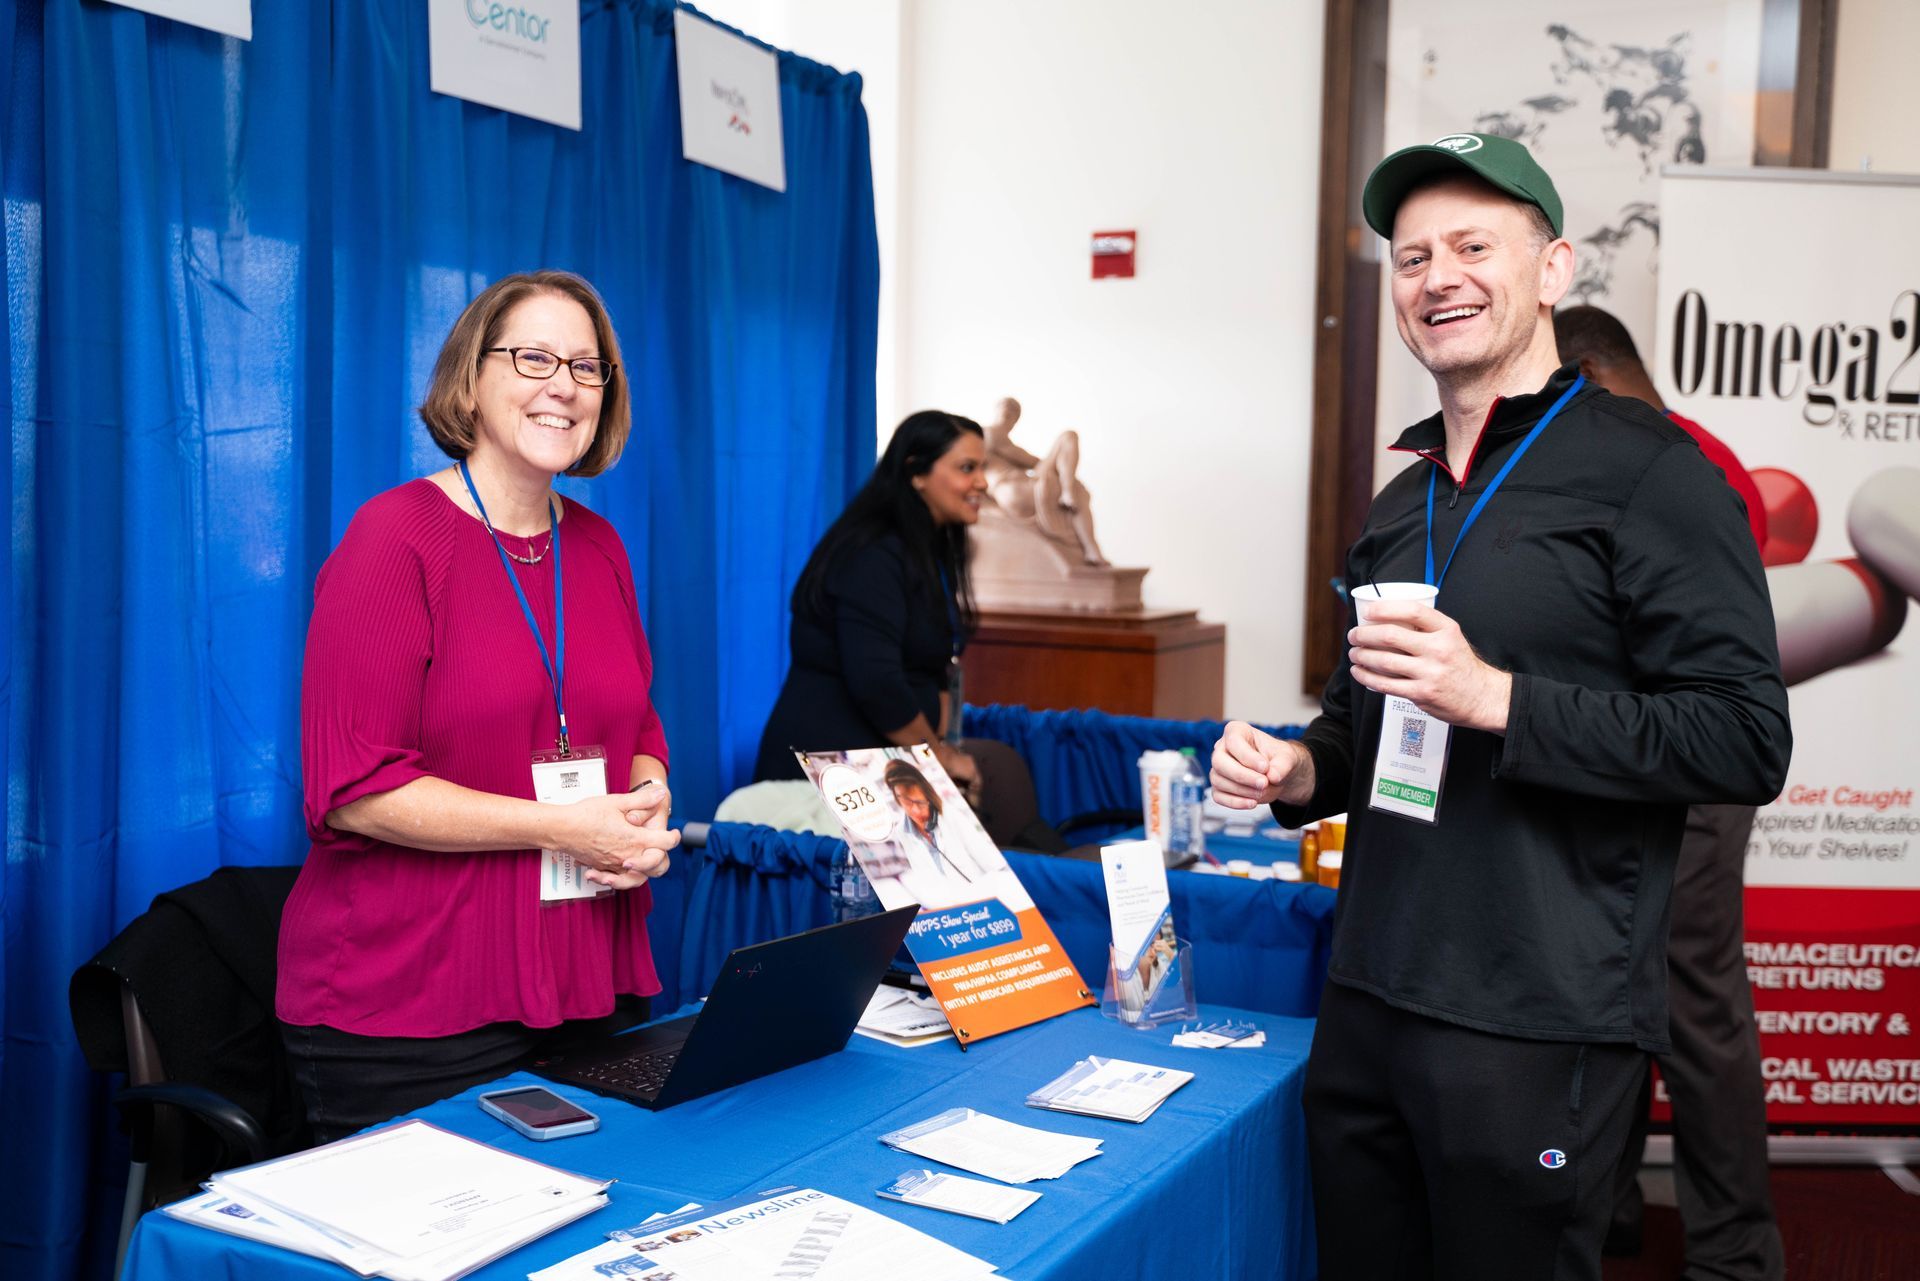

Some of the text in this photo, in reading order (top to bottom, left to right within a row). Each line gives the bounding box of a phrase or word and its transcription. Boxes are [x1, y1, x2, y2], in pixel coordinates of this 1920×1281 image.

[1864, 411, 1920, 442] RET
[1400, 786, 1431, 805] MEMBER
[1788, 784, 1914, 812] Get Caught
[1752, 813, 1920, 835] xpired Medicatio
[1768, 839, 1813, 858] Your
[1817, 837, 1909, 862] Shelves!
[940, 914, 962, 928] Show
[961, 906, 991, 925] Special
[938, 918, 1016, 949] 1 year for $899
[930, 943, 1051, 982] INCLUDES AUDIT ASSISTANCE AND
[1742, 942, 1920, 967] RMACEUTIC
[995, 960, 1046, 982] COMPLIANCE
[1746, 965, 1886, 991] RETURNS
[965, 993, 979, 1005] NY
[977, 983, 1016, 1001] MEDICAID
[1014, 966, 1074, 992] REQUIREMENTS)
[1754, 1010, 1911, 1036] ENTORY &
[1760, 1057, 1821, 1081] CAL
[1765, 1081, 1920, 1106] AL SERVIC
[697, 1192, 825, 1234] Newsline
